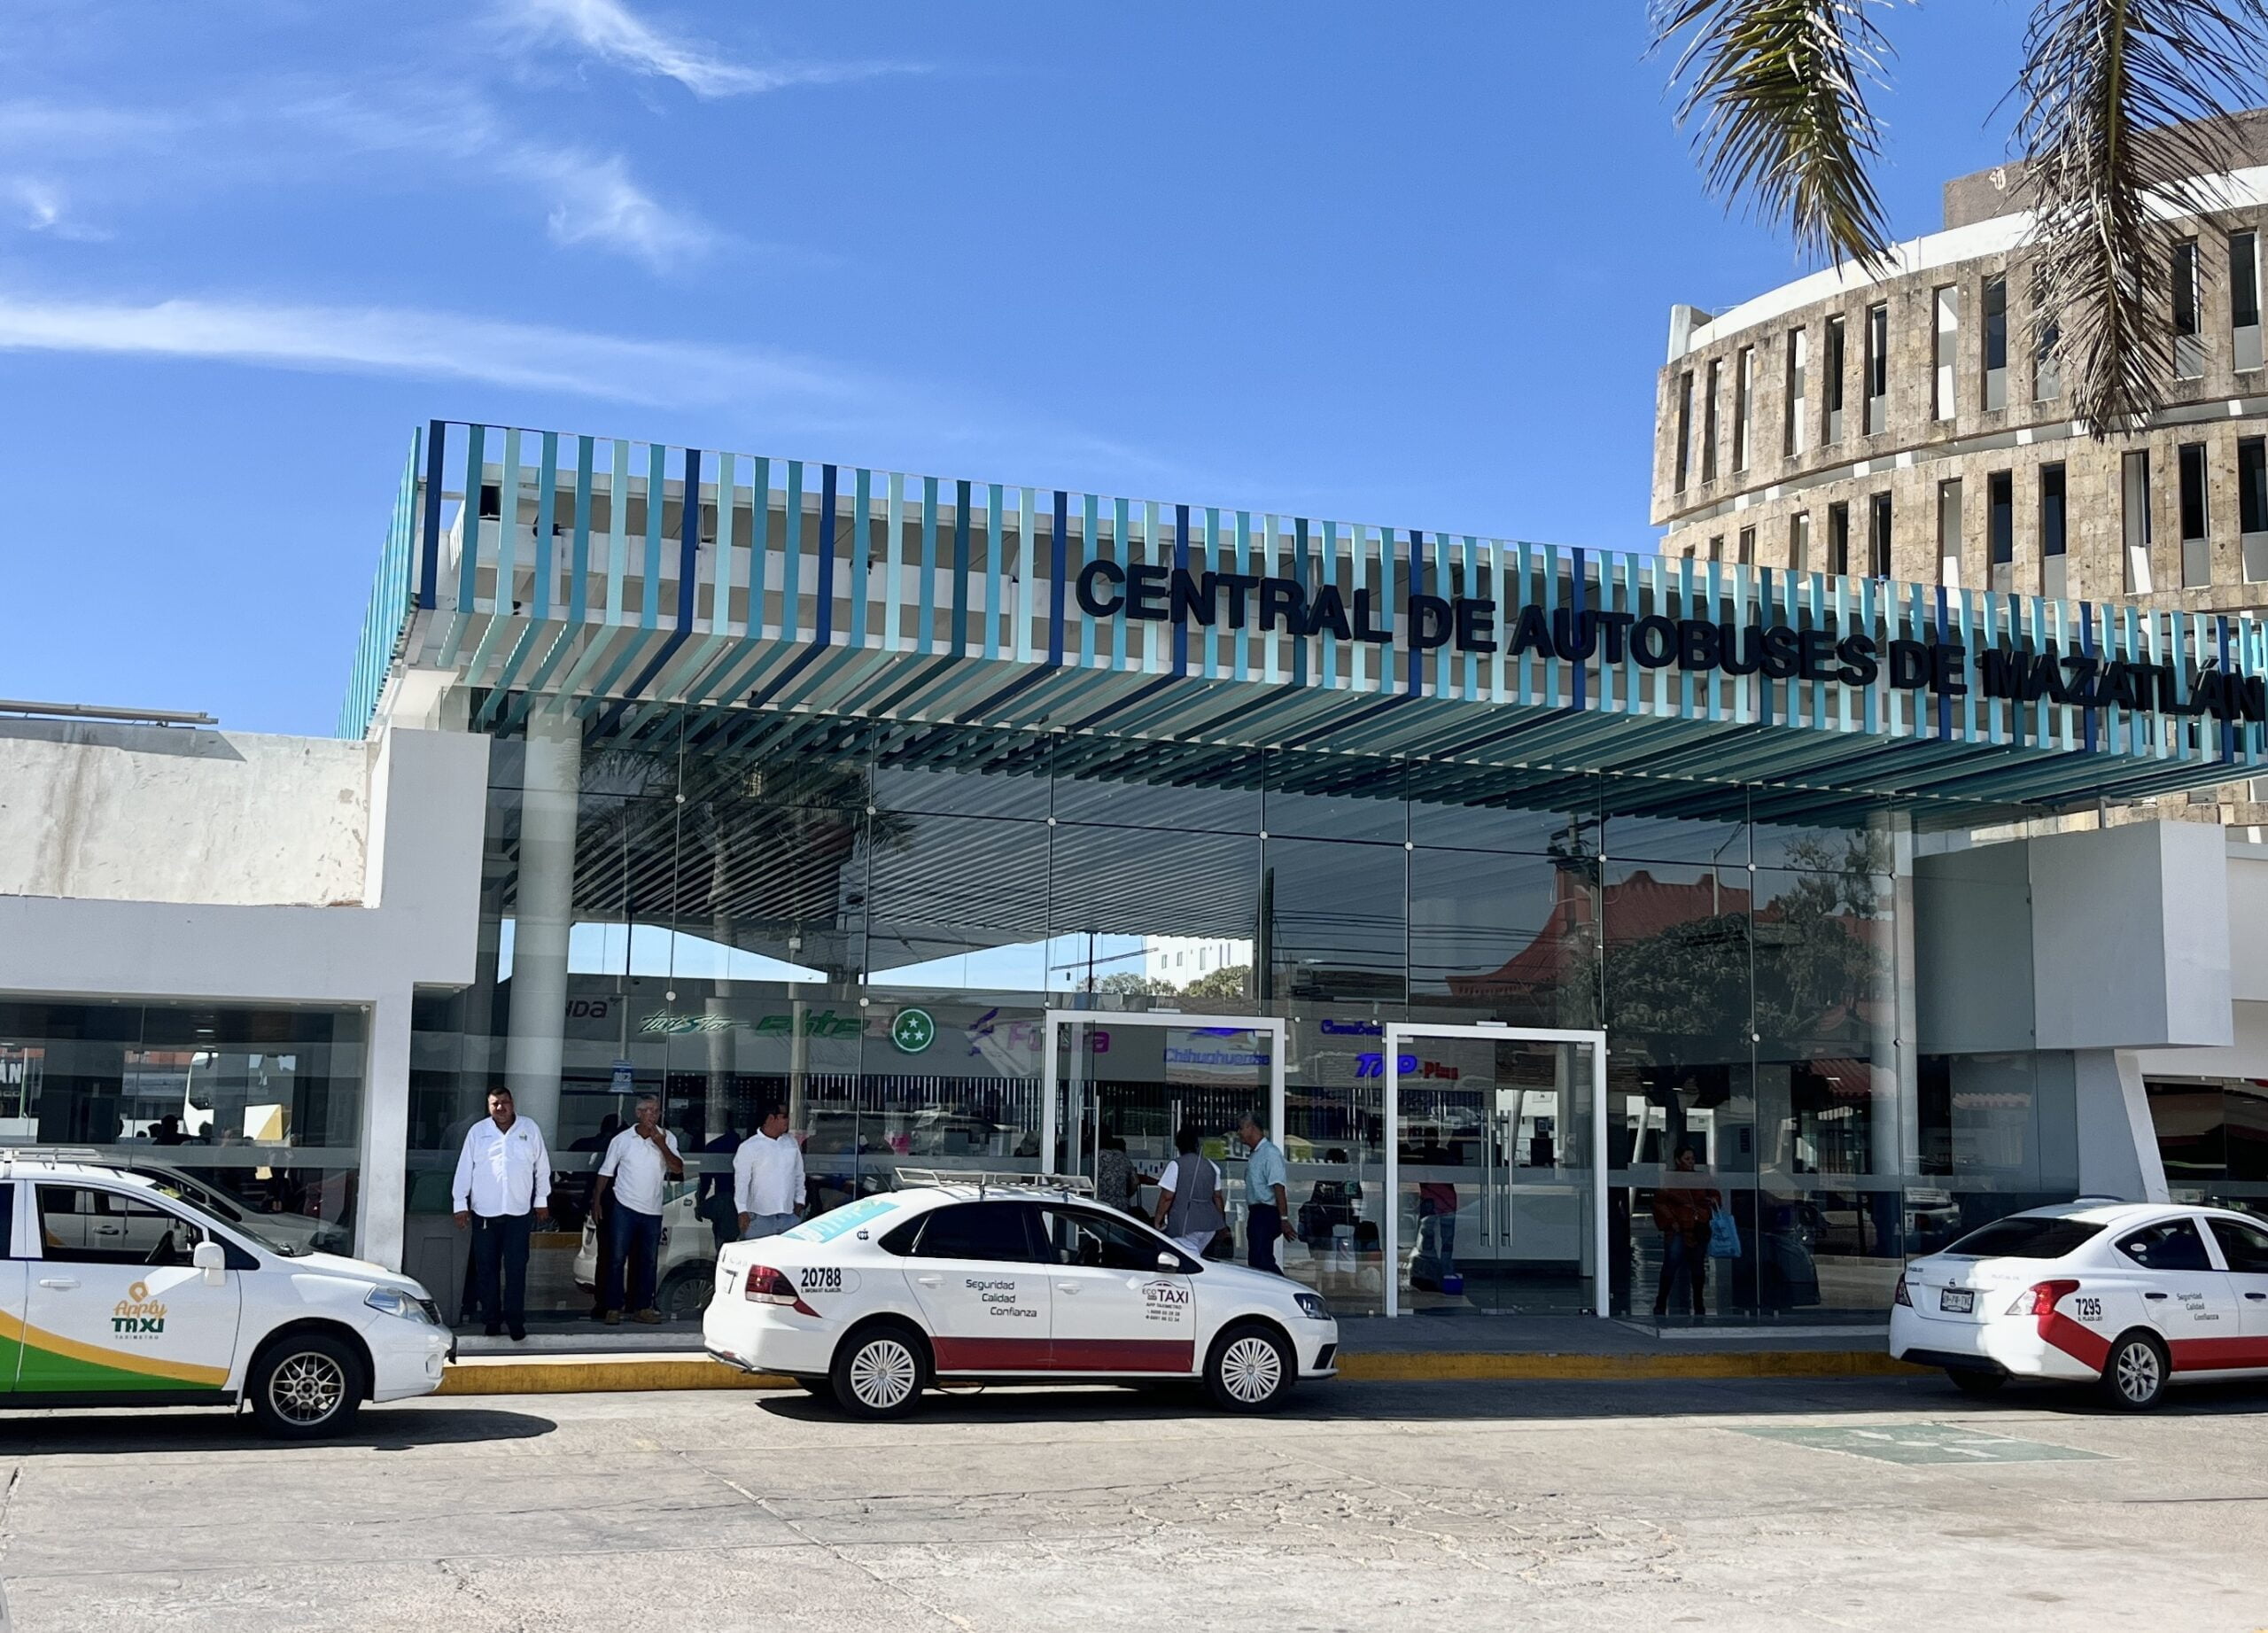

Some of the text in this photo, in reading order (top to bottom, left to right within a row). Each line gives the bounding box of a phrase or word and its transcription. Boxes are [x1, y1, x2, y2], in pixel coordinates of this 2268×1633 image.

[1076, 558, 2265, 722] CENTRAL DE AUTOBUSES DE MAZATLÁN
[801, 1267, 842, 1287] 20788
[966, 1279, 1015, 1291] Seguridad
[982, 1293, 1016, 1303] Calidad
[1157, 1288, 1189, 1304] TAXI
[2177, 1292, 2202, 1303] Seguridad
[113, 1299, 167, 1318] Apply
[990, 1306, 1037, 1318] Confianza
[2075, 1298, 2101, 1316] 7295
[2186, 1302, 2205, 1311] Calidad
[2194, 1312, 2219, 1321] Confianza
[111, 1318, 165, 1333] TAXI
